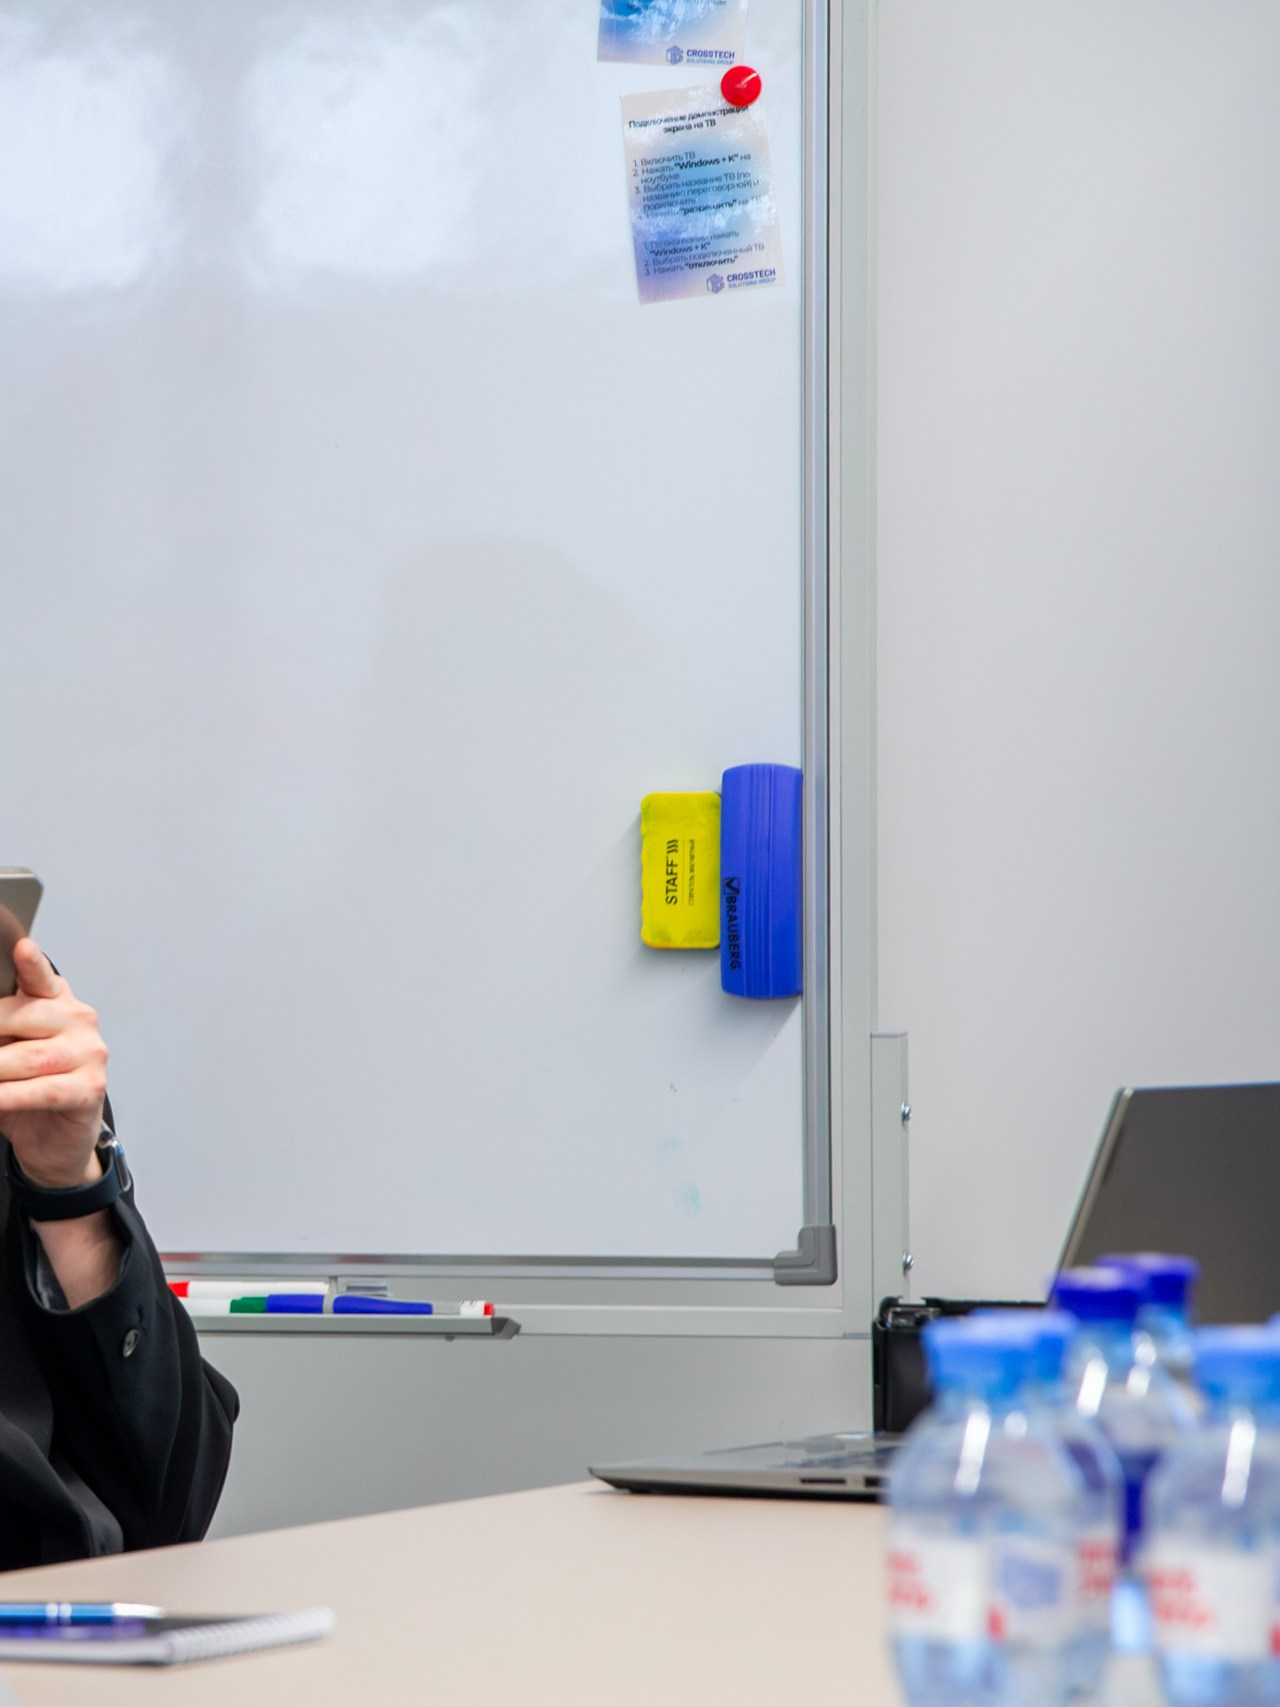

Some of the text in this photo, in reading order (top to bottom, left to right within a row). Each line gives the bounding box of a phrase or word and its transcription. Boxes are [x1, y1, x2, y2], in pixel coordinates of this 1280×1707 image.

[687, 49, 735, 59] CROSSTECH
[726, 267, 776, 283] CROSSTECH
[665, 860, 679, 905] STAFF
[725, 896, 741, 970] BRAUBERG
